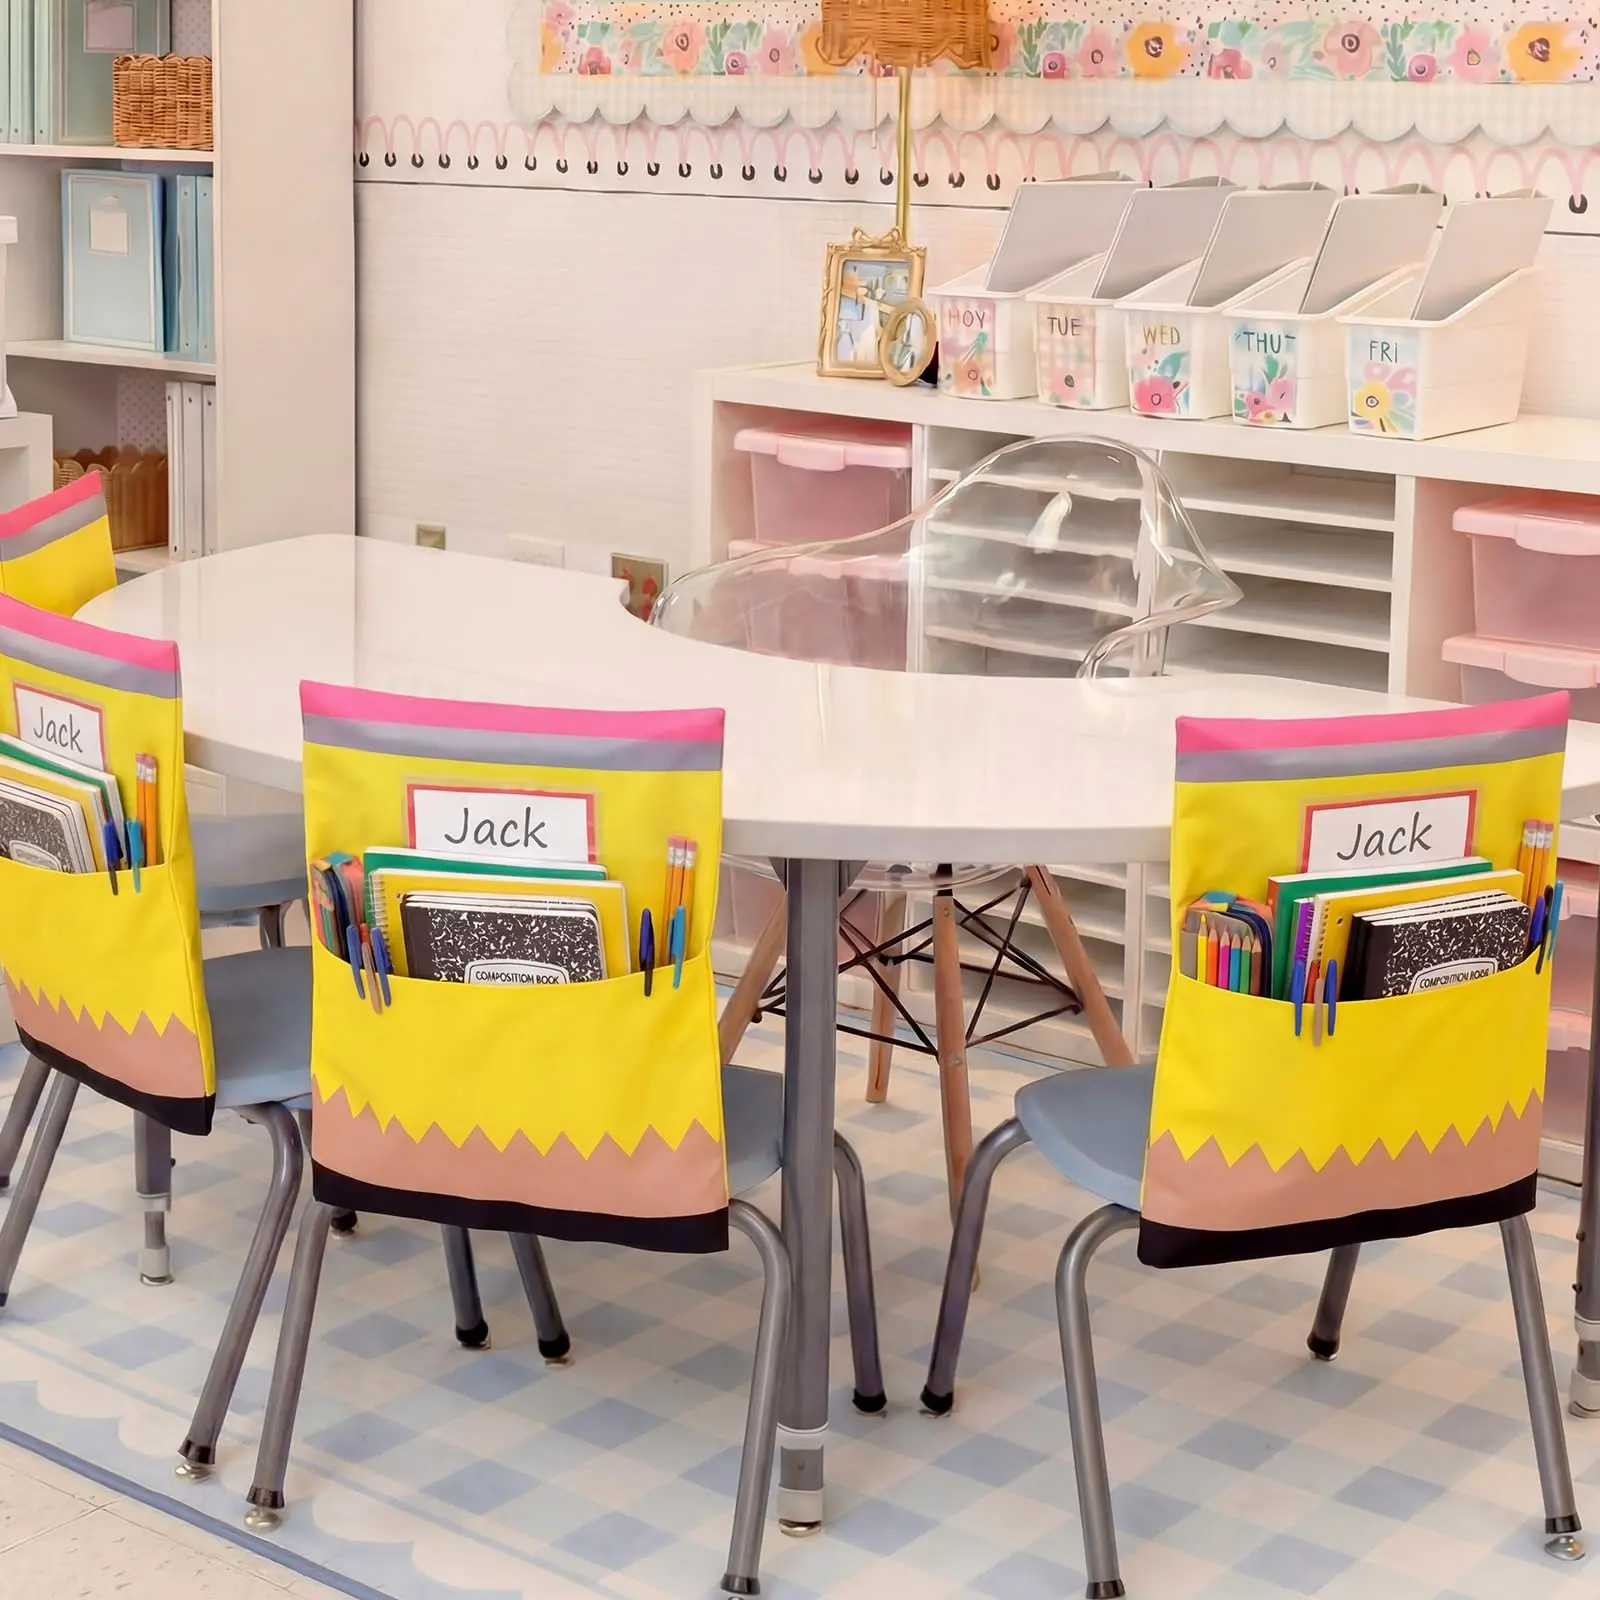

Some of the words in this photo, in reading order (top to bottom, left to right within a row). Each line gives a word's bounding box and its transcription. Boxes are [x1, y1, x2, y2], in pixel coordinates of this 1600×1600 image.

[1047, 316, 1083, 336] TUE
[1142, 326, 1181, 346] WED
[1243, 331, 1281, 354] THU
[1369, 340, 1398, 363] FRI
[33, 706, 83, 753] Jack
[444, 806, 548, 849] Jack
[1336, 811, 1433, 861] Jack
[475, 970, 534, 985] COMPOSITION
[536, 975, 560, 985] BOOK
